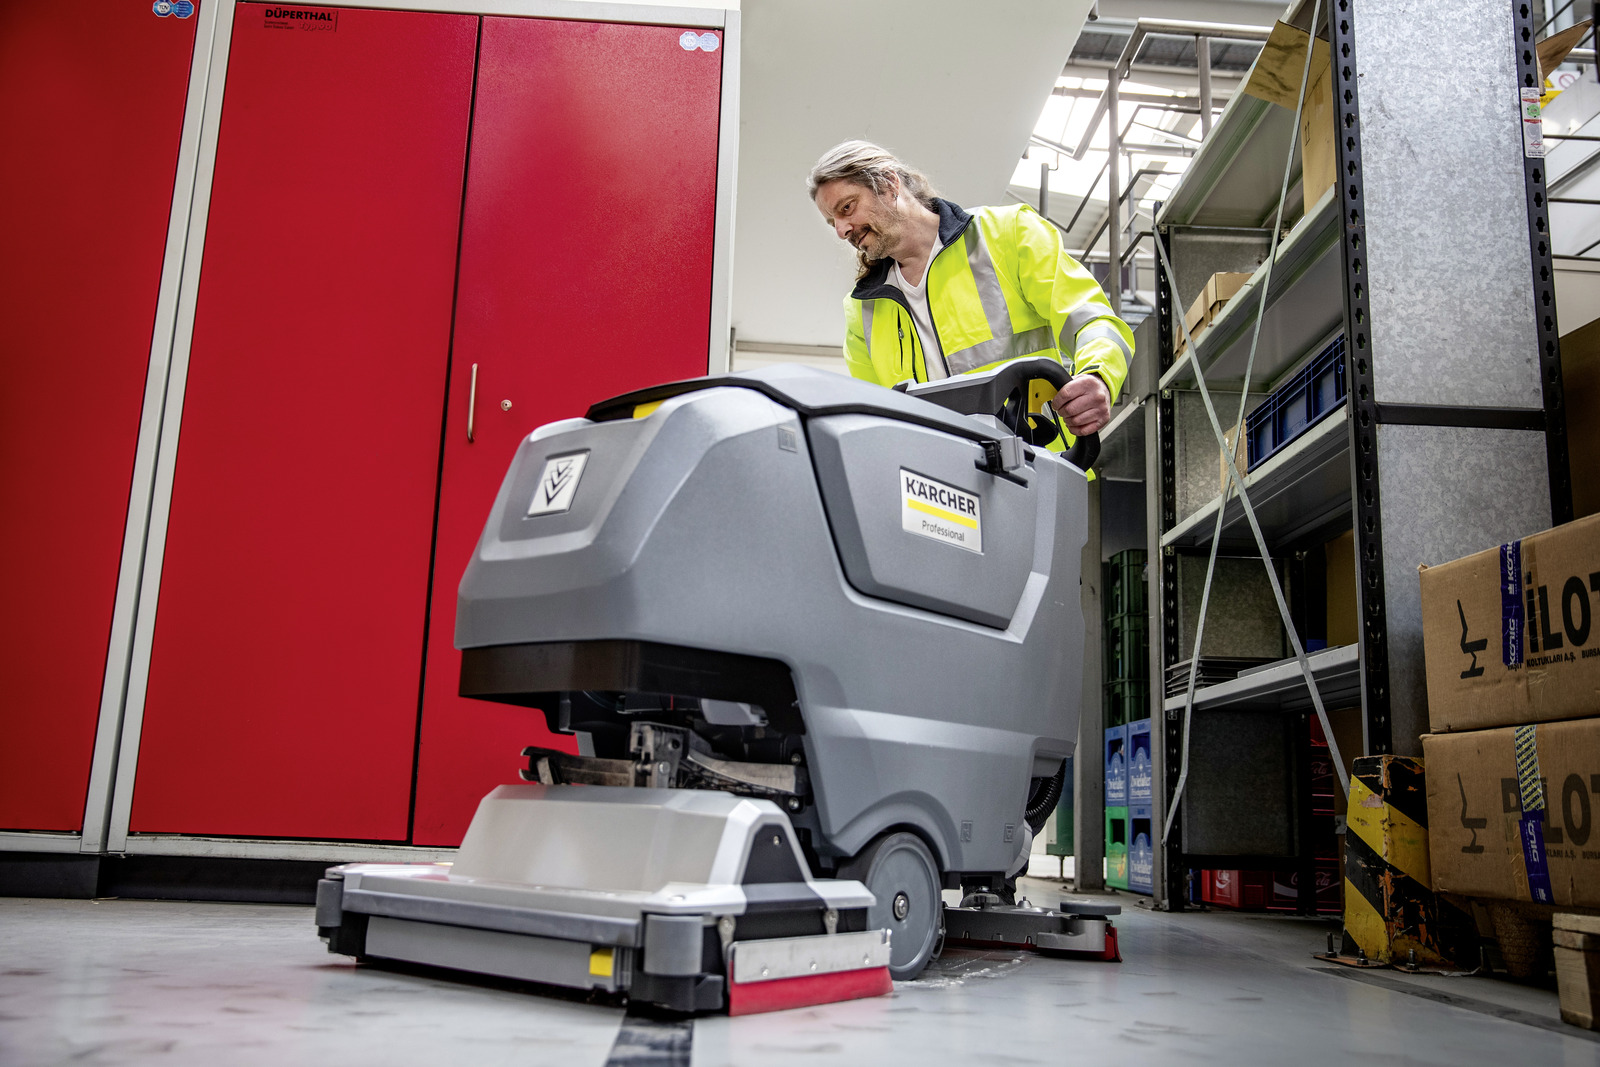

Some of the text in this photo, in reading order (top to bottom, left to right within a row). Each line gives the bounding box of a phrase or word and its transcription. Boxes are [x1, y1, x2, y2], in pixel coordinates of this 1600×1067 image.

[265, 8, 333, 21] DÜPERTHAL
[906, 477, 976, 516] KÄRCHER
[922, 520, 965, 541] Professional
